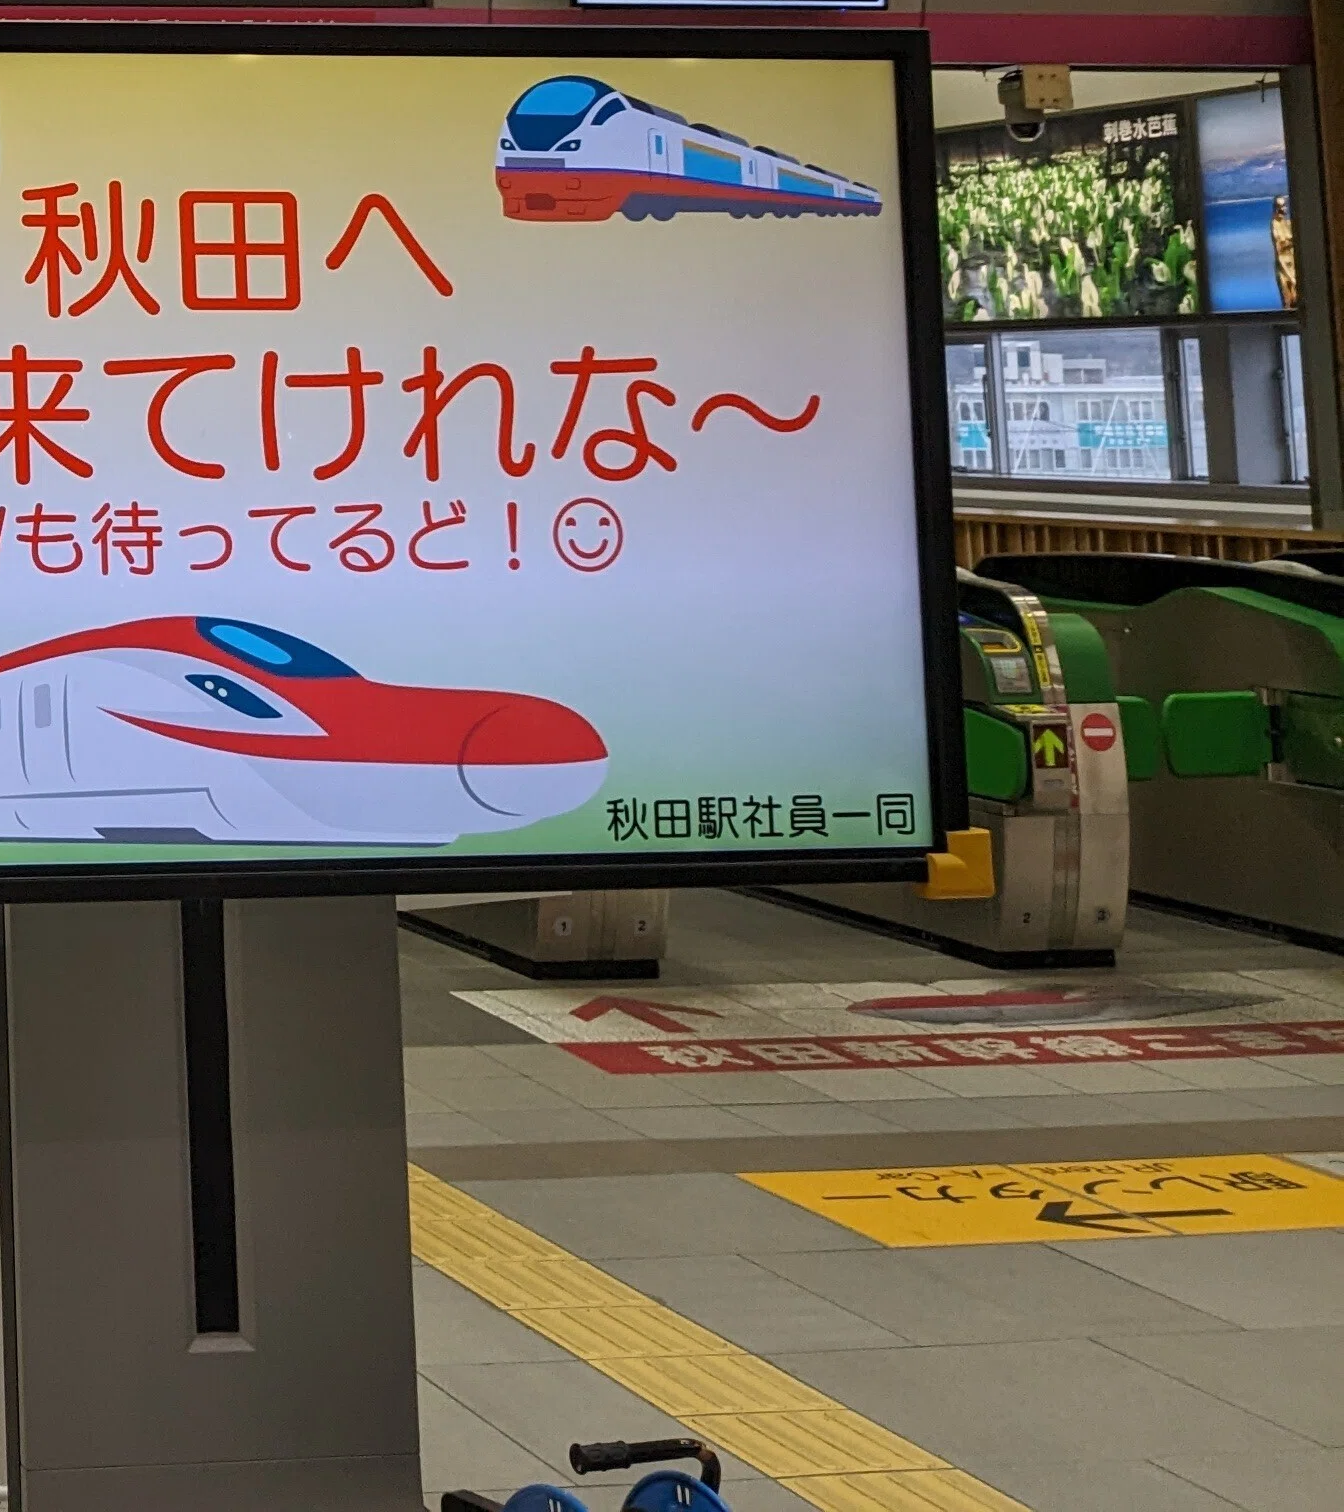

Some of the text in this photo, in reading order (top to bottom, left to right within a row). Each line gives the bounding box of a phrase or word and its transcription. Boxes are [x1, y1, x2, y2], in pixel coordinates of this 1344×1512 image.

[21, 180, 454, 319] 秋田へ
[607, 791, 915, 842] 秋田駅社員一同
